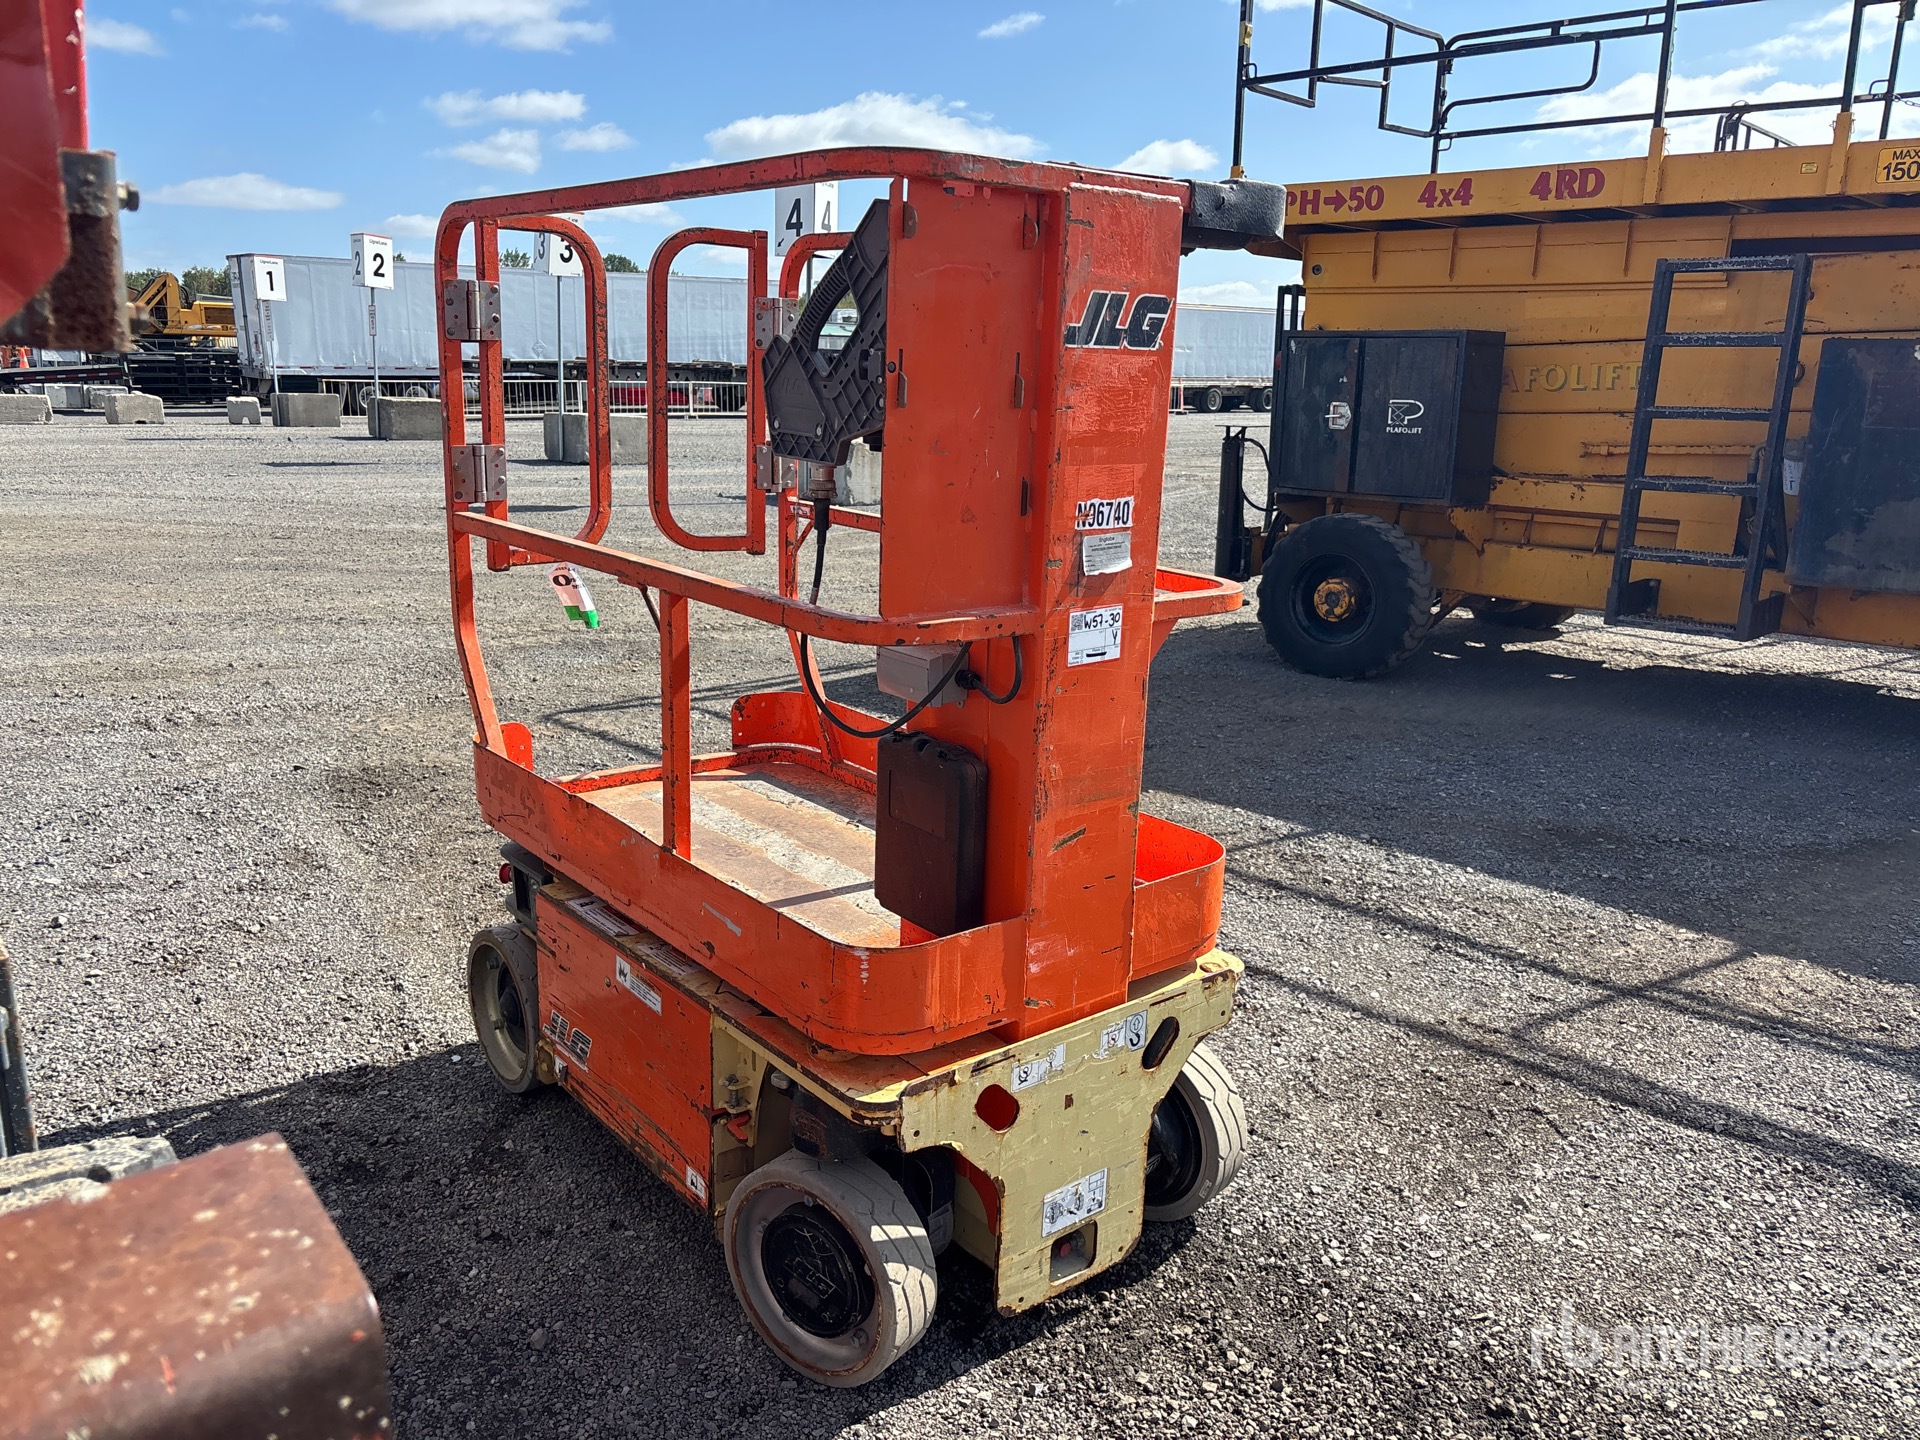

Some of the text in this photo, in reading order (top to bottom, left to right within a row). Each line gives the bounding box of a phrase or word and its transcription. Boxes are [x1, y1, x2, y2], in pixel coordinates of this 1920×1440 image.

[1892, 149, 1920, 161] MAX
[1417, 177, 1474, 208] 4x4
[785, 197, 803, 237] 4
[821, 200, 831, 233] 4
[537, 232, 546, 260] 3
[559, 237, 574, 264] 3
[354, 250, 361, 276] 2
[372, 252, 386, 278] 2
[266, 270, 274, 292] 1
[1064, 289, 1174, 350] JLG
[1386, 426, 1423, 435] PLAFOLIFT
[1076, 500, 1131, 529] N96740
[1083, 612, 1121, 630] W57-30
[543, 1010, 592, 1072] JLG
